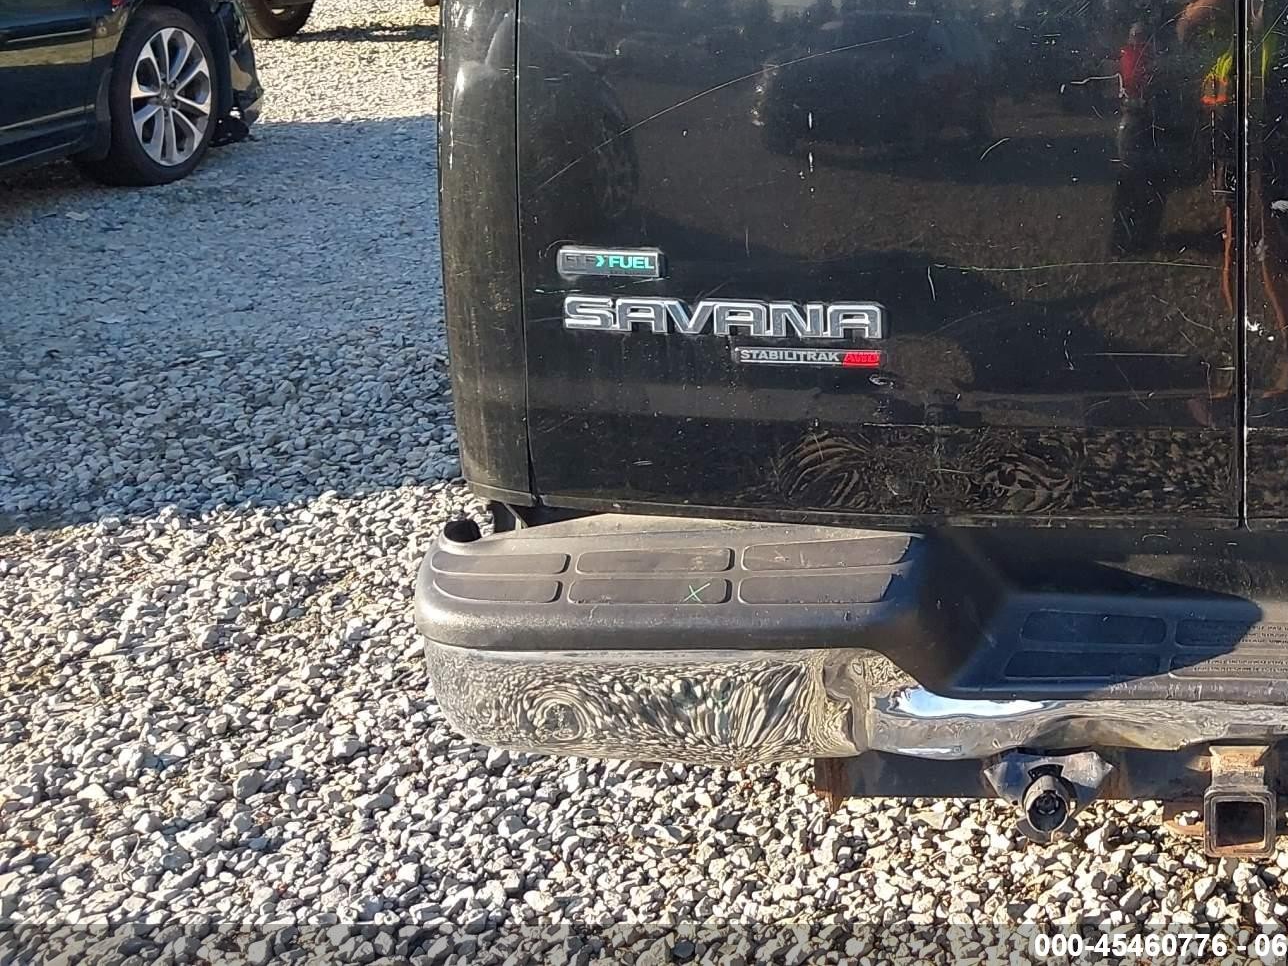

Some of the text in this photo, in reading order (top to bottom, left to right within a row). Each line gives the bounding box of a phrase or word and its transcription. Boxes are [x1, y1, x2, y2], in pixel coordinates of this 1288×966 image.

[608, 255, 655, 269] FUEL
[564, 295, 882, 339] SAVANA
[740, 349, 839, 362] STABILITRAK
